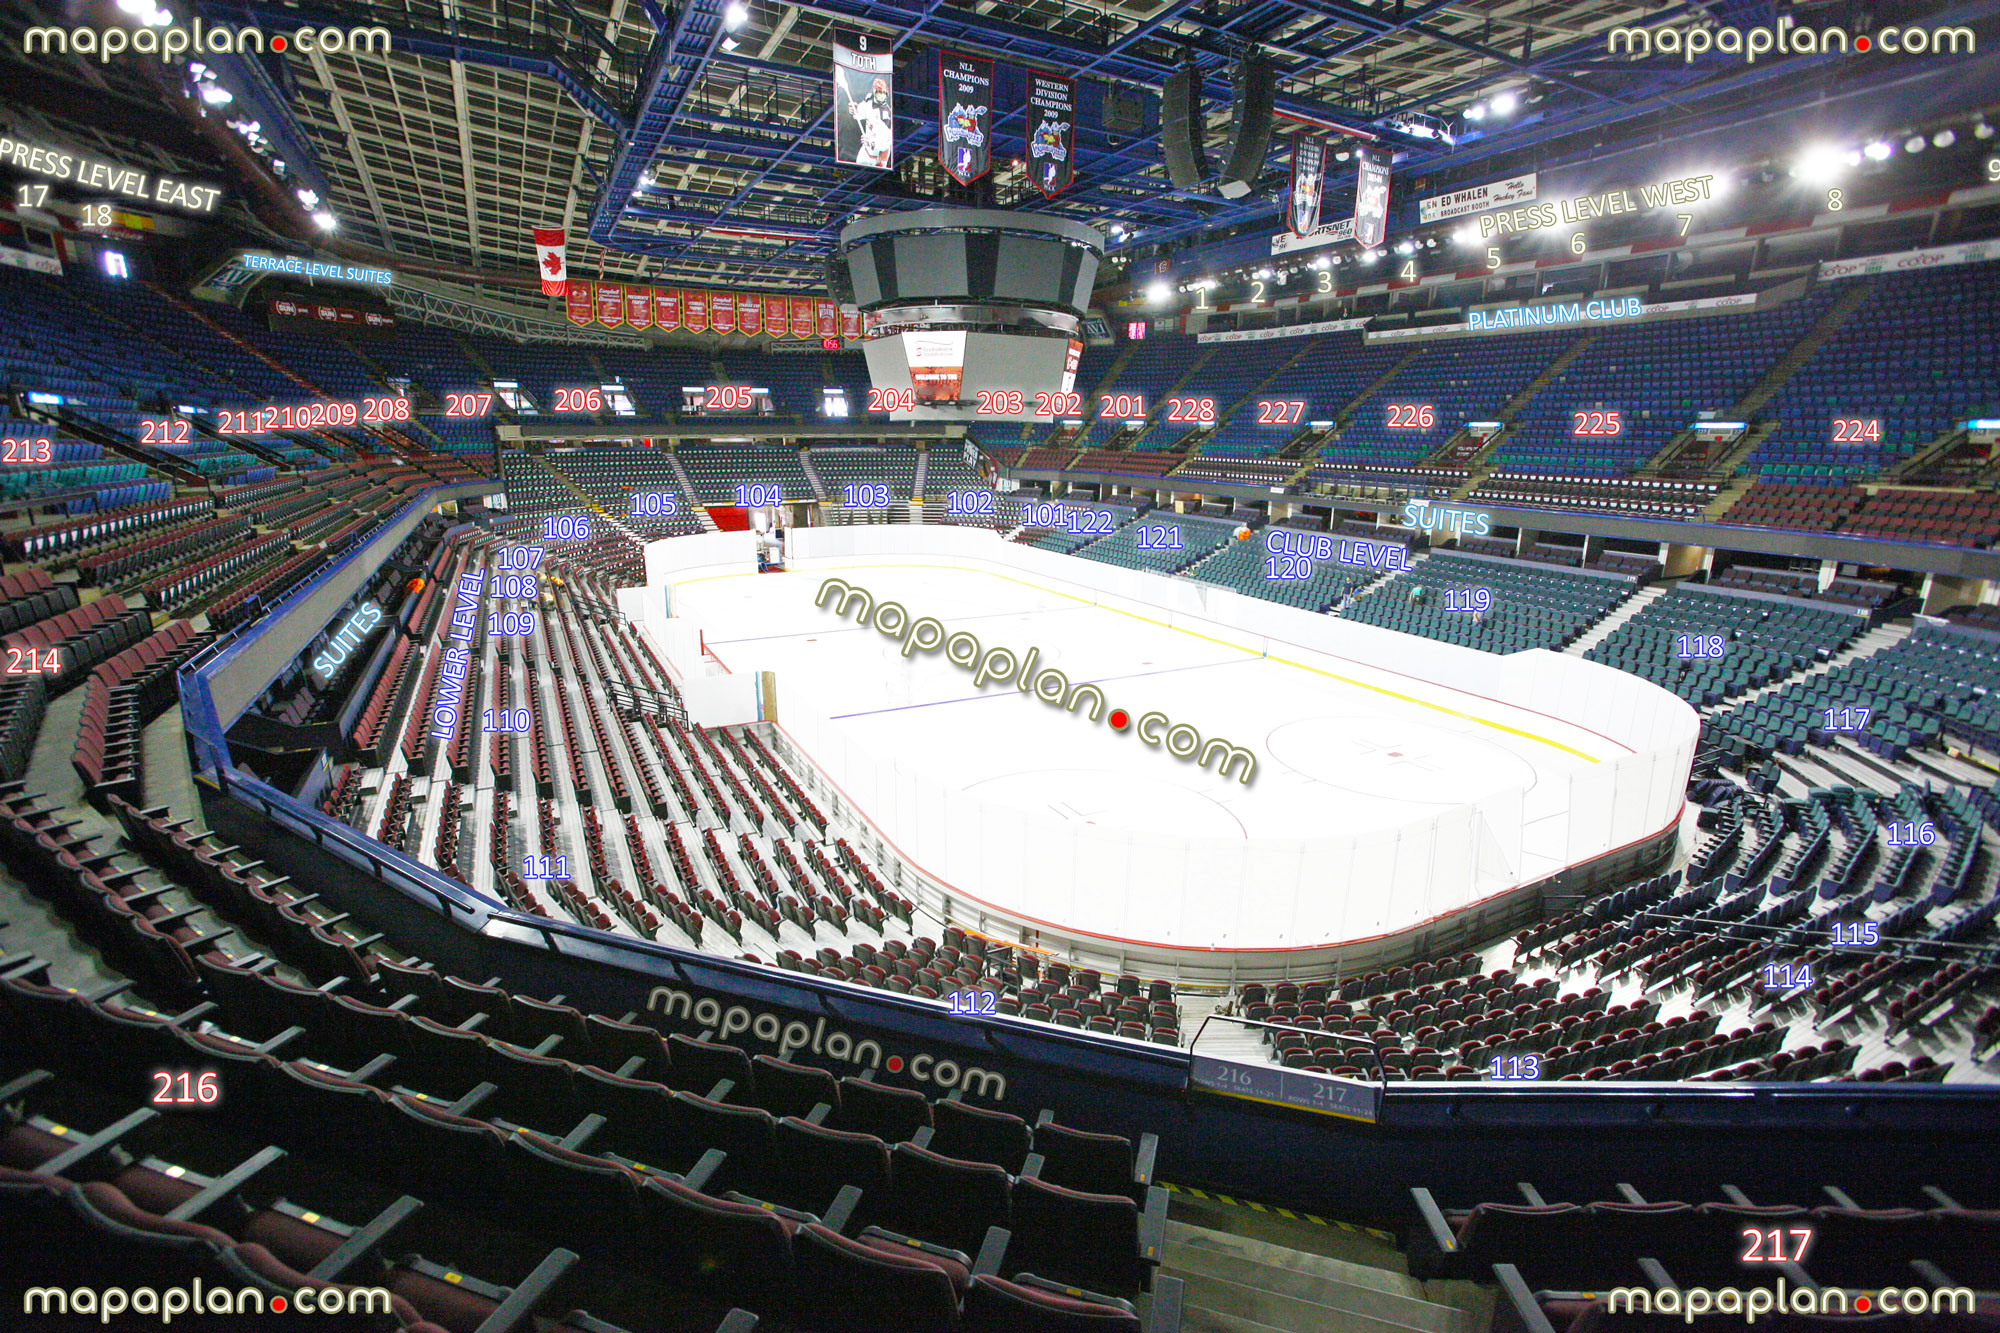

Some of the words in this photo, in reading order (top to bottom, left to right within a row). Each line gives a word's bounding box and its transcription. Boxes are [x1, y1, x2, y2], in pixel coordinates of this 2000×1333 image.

[859, 35, 867, 51] 9
[851, 52, 876, 70] TOTH
[959, 62, 975, 72] NLL
[943, 69, 989, 86] CHAMPIONS
[1035, 79, 1069, 92] WESTERN
[958, 84, 974, 94] 2009
[1036, 88, 1068, 101] DIVISION
[1030, 97, 1072, 111] CHAMPIONS
[1044, 109, 1059, 119] 2009
[1441, 196, 1452, 207] ED
[1454, 187, 1488, 203] WHALEN
[1440, 205, 1470, 217] BROADCAST
[1472, 201, 1490, 210] BOOTH
[1217, 1065, 1252, 1085] 216
[1313, 1083, 1347, 1102] 217
